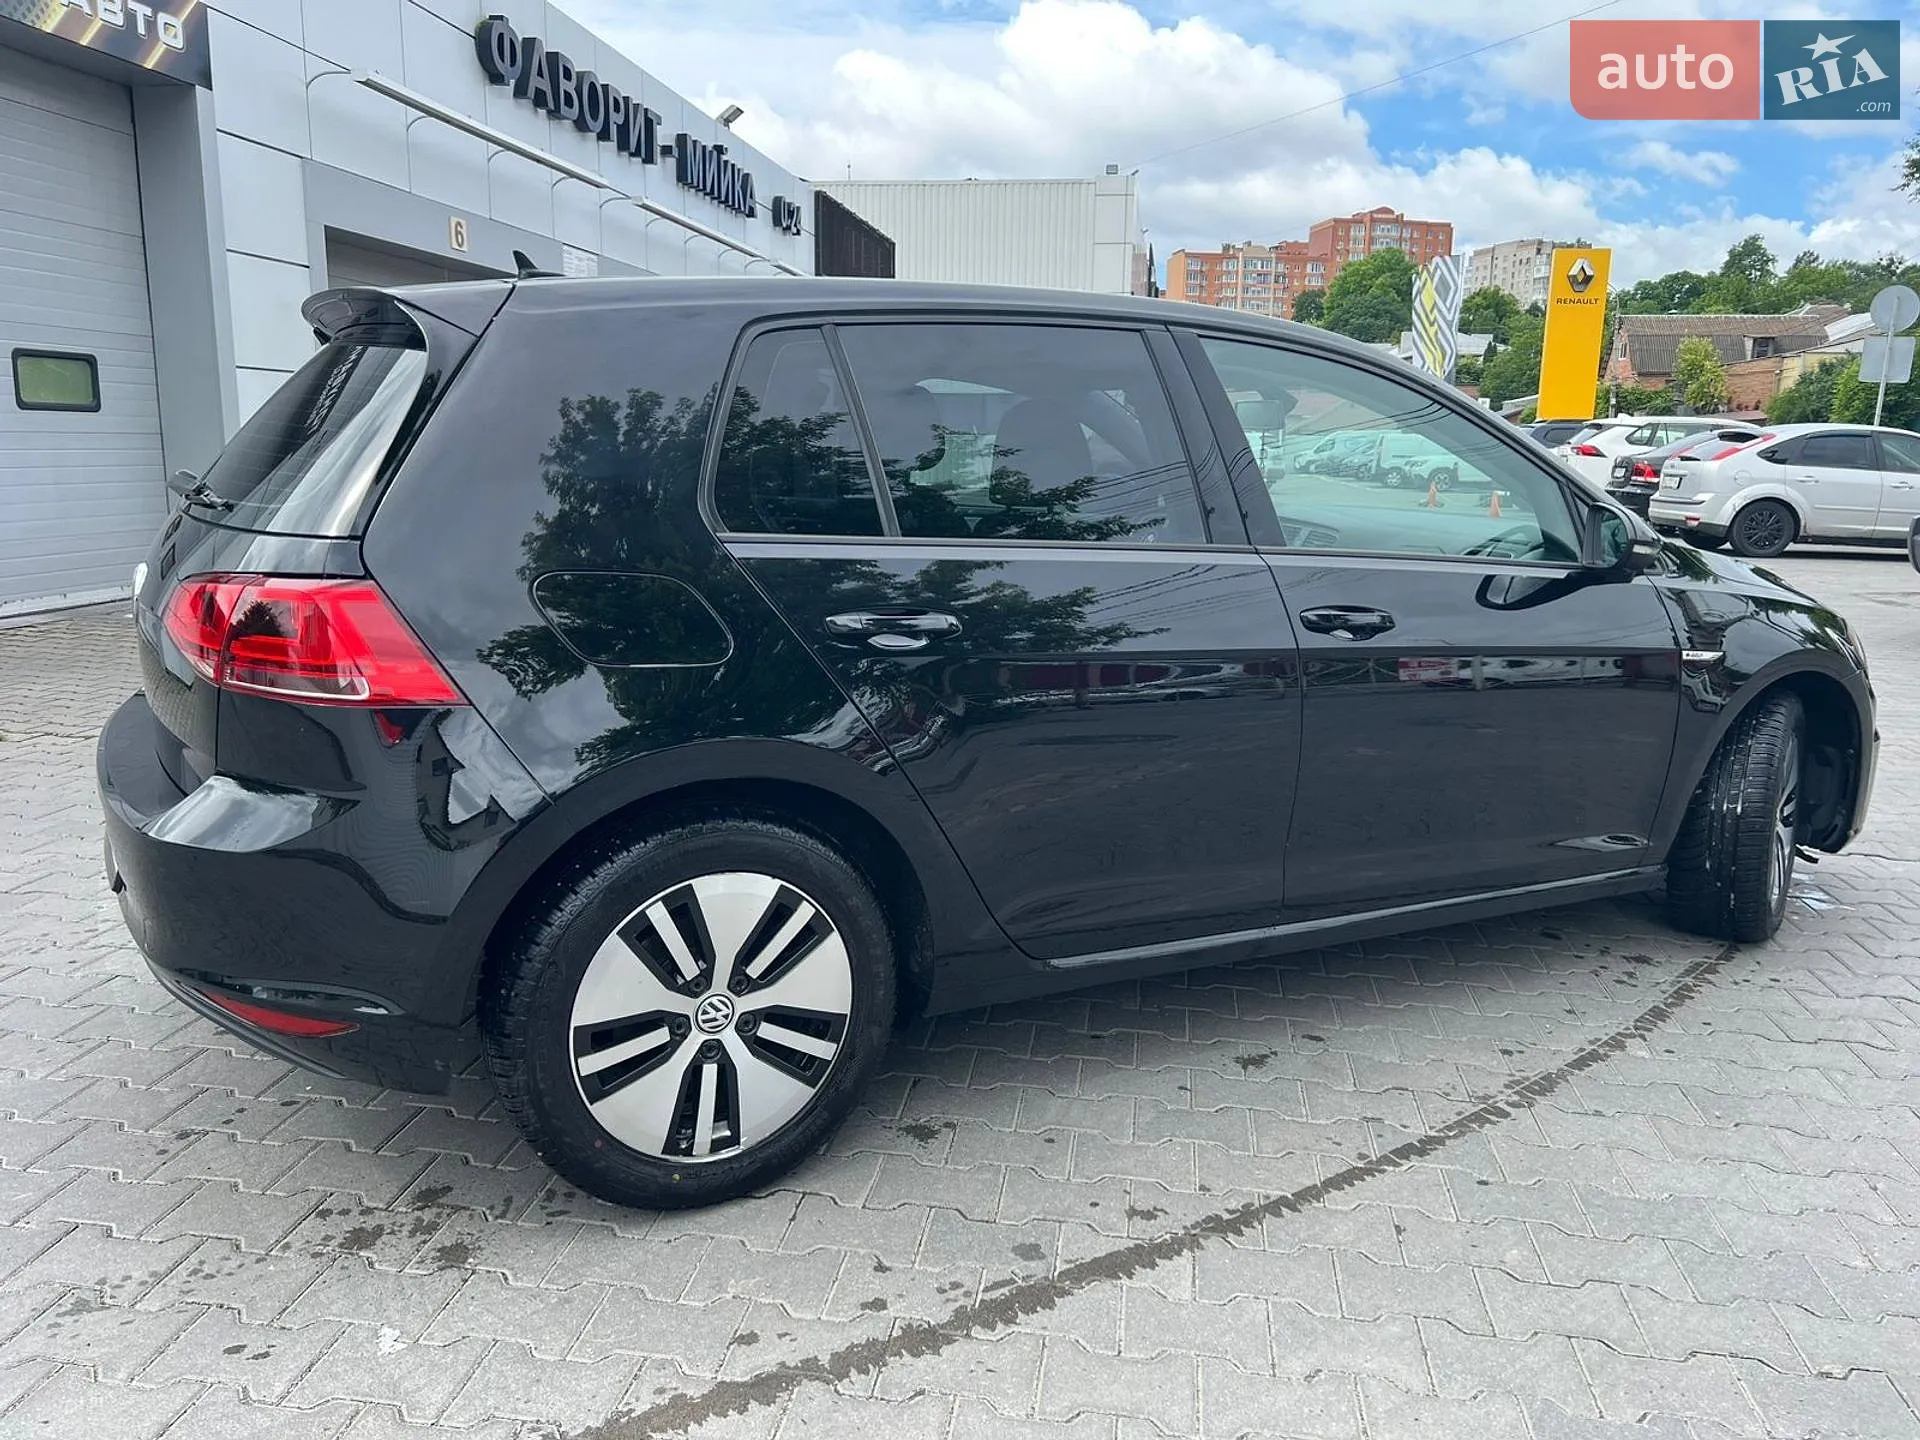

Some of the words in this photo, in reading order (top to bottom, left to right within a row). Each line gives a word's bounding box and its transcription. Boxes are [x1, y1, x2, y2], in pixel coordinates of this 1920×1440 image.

[475, 15, 662, 165] ФАВОРИТ
[675, 133, 757, 218] МИЙКА
[454, 221, 465, 248] 6
[1556, 297, 1600, 305] RENAULT
